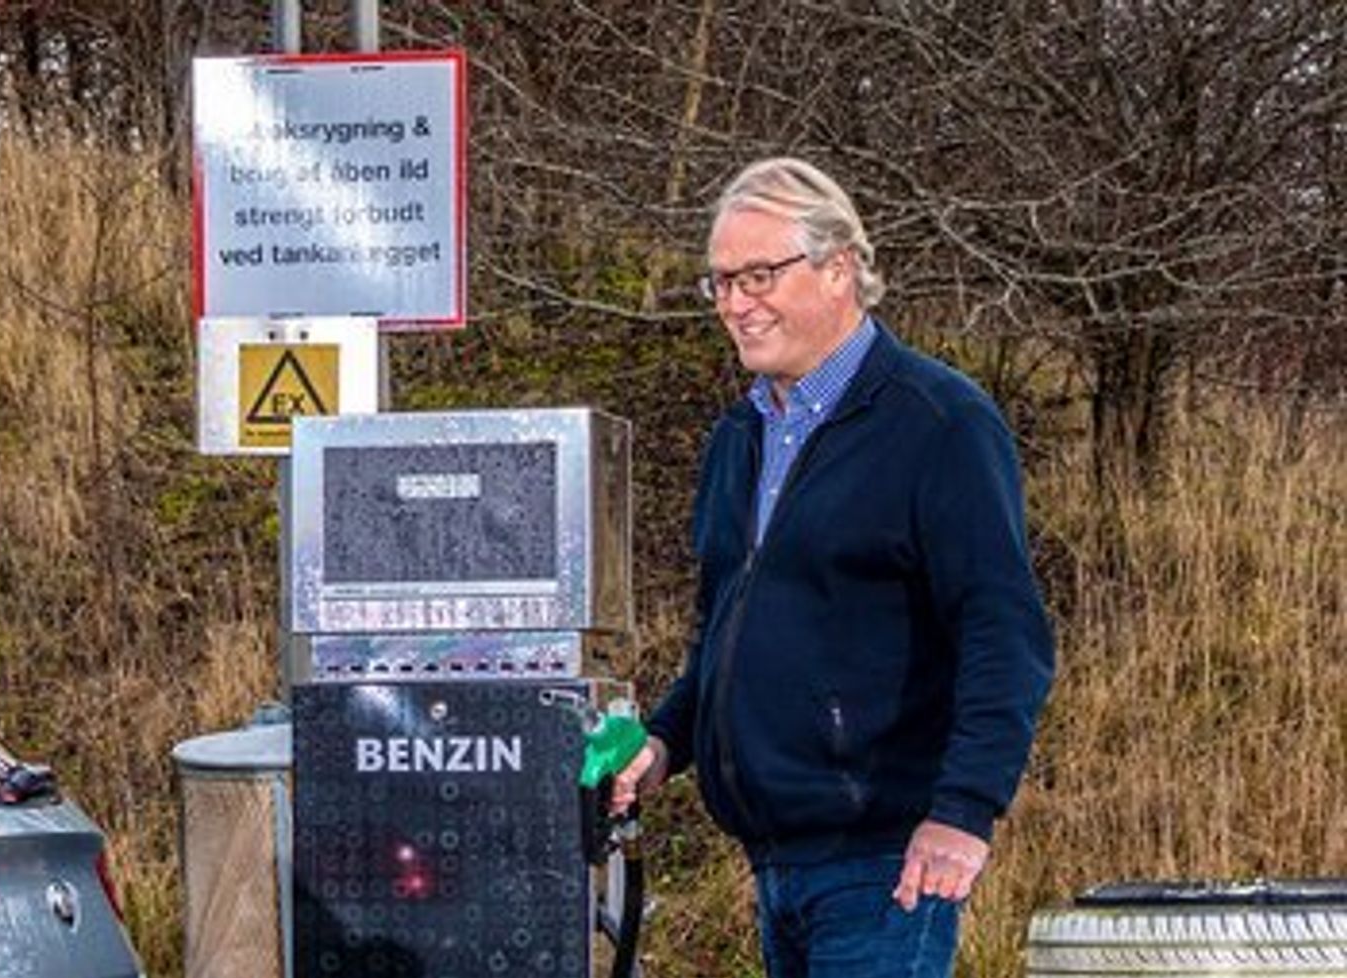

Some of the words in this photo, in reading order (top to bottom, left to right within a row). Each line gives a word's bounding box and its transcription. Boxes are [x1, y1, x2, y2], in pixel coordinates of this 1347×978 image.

[412, 115, 431, 137] &
[399, 159, 429, 180] ild
[234, 204, 323, 230] strengt
[219, 243, 263, 266] ved
[357, 737, 521, 772] BENZIN
